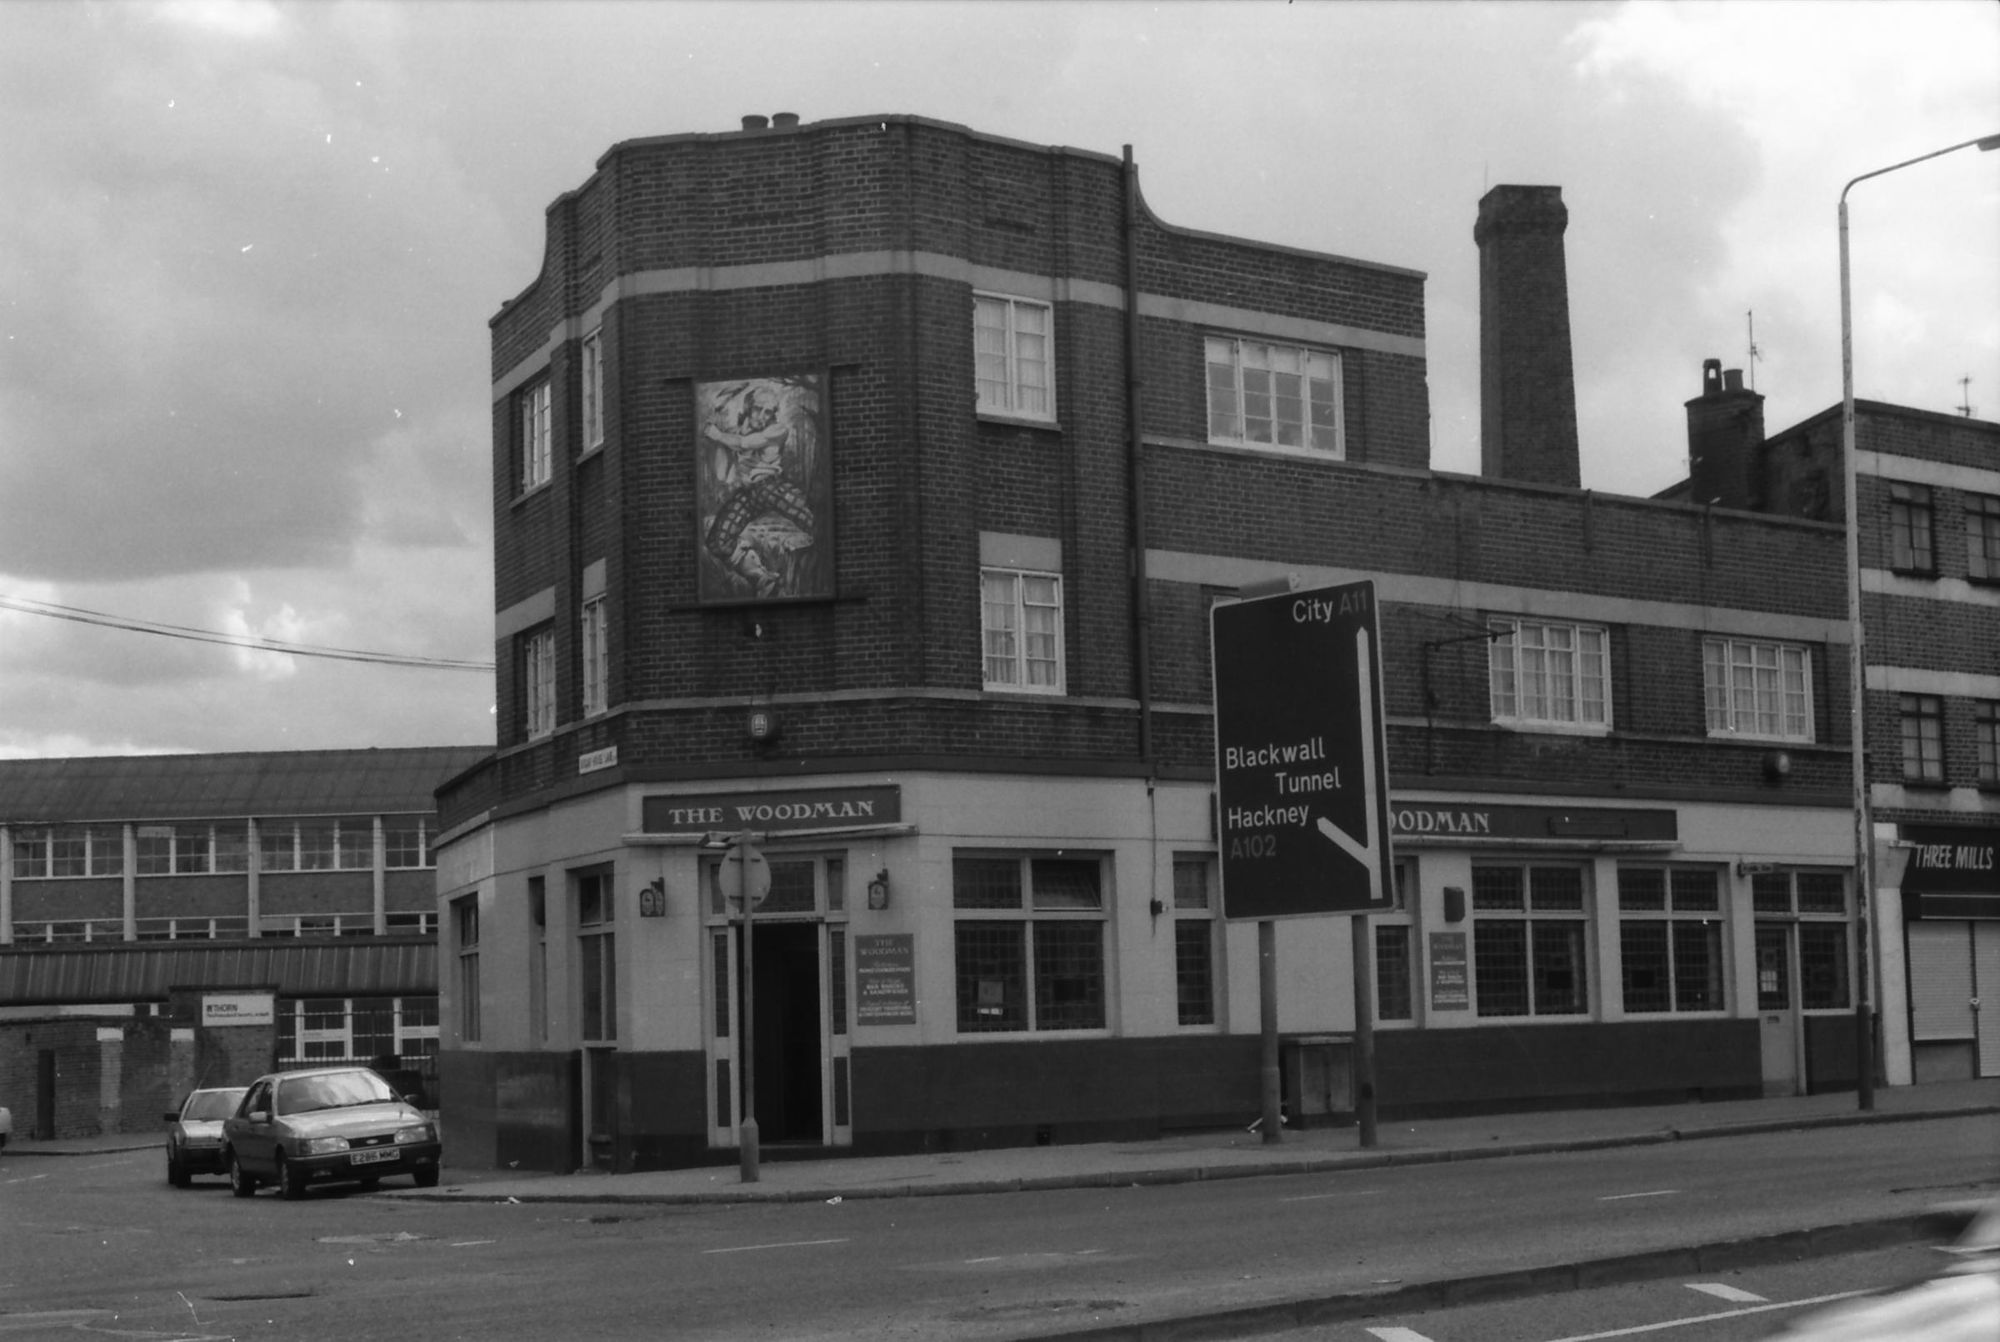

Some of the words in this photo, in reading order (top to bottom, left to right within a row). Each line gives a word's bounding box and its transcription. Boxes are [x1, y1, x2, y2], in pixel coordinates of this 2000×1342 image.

[1292, 598, 1333, 624] City
[1339, 589, 1367, 615] A11
[1226, 736, 1325, 770] Blackwall
[1275, 766, 1341, 795] Tunnel
[669, 807, 724, 825] THE
[736, 800, 875, 822] WOODMAN
[1228, 804, 1309, 830] Hackney
[1230, 834, 1276, 860] A102
[1915, 844, 1953, 869] THREE
[1955, 845, 1994, 870] MILLS
